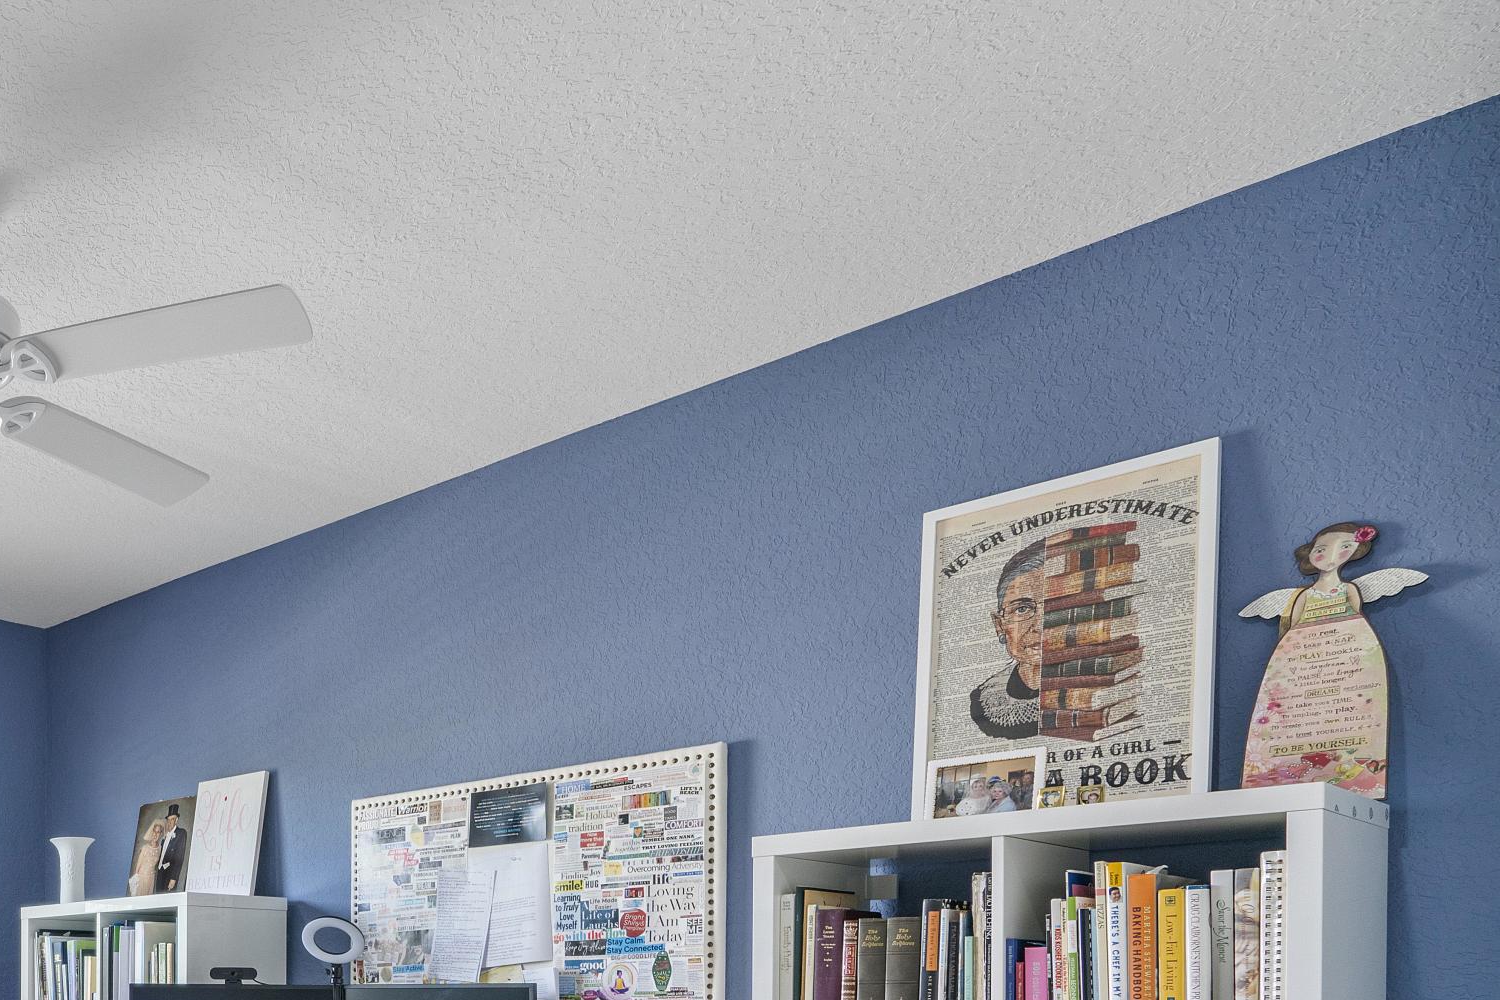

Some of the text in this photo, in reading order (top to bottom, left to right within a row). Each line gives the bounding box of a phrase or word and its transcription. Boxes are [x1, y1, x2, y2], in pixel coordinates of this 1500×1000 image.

[941, 531, 1005, 579] NEVER
[1009, 499, 1200, 537] UNDERESTIMATE
[1063, 747, 1087, 762] OF
[1091, 745, 1104, 759] A
[1110, 739, 1156, 756] GIRL
[1274, 746, 1288, 755] TO
[1291, 744, 1304, 752] BE
[1078, 752, 1193, 788] BOOK
[624, 782, 653, 791] ESCAPES
[399, 803, 429, 815] Warrior
[585, 809, 618, 820] Holiday
[568, 822, 603, 833] tradition
[664, 820, 703, 830] COMFORT
[627, 863, 671, 873] Overcoming
[555, 880, 583, 892] smile!
[585, 880, 599, 888] HUG
[647, 885, 695, 899] Loving
[553, 894, 581, 903] Learning
[1190, 893, 1200, 915] CRAIG
[555, 903, 580, 913] to Truly
[646, 899, 697, 914] the Way
[560, 912, 575, 920] Love
[581, 909, 617, 920] Life of
[624, 912, 645, 922] Bright
[1096, 904, 1104, 929] PIZZAS
[556, 921, 577, 931] Myself
[581, 920, 619, 932] Laughs
[687, 918, 703, 926] SEE
[1111, 905, 1120, 937] THERE'S
[1132, 906, 1141, 945] BAKING
[1143, 906, 1151, 948] MARTHA
[688, 926, 703, 934] ME
[607, 938, 623, 947] Stay
[646, 930, 683, 946] Today
[607, 946, 623, 955] Stay
[1165, 913, 1178, 991] Low-Fat Living
[1111, 949, 1121, 970] CHEF
[580, 961, 606, 973] good
[1111, 973, 1121, 982] IN
[1191, 961, 1200, 990] KITCHEN
[1112, 986, 1122, 998] MY
